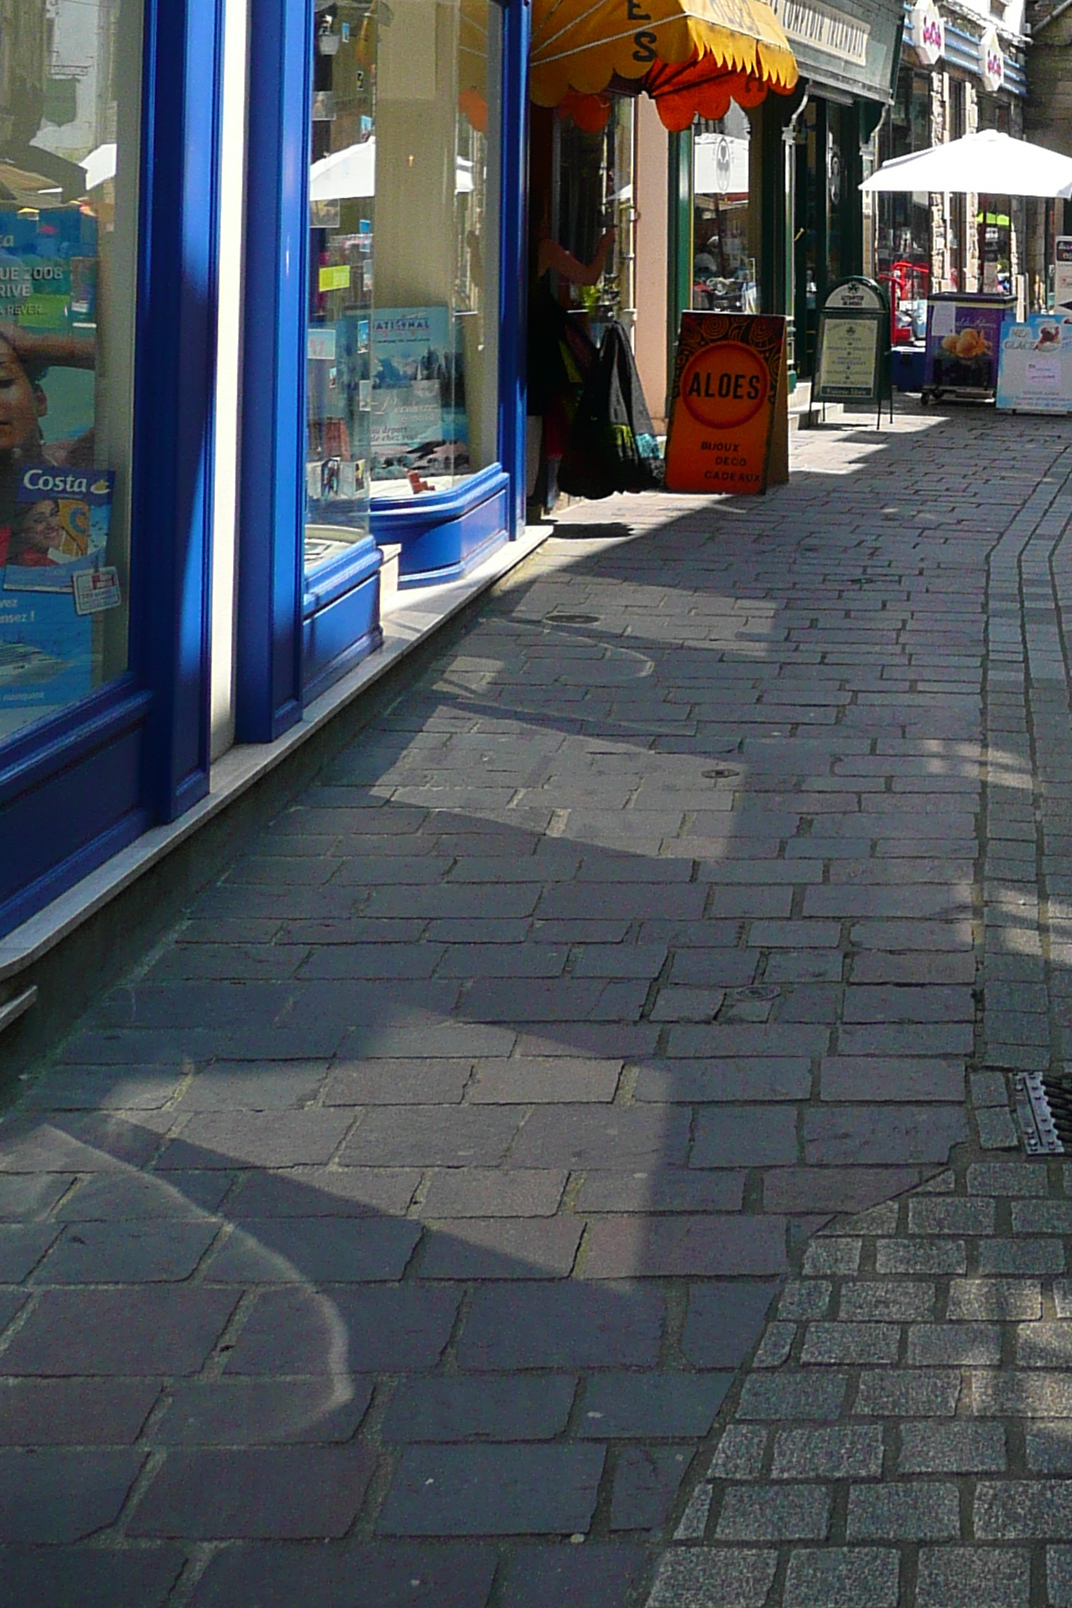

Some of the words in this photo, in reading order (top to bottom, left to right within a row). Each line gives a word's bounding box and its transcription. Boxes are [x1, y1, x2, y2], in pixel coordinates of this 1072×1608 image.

[688, 371, 760, 400] ALOES
[701, 441, 739, 452] BIJOUX
[715, 456, 747, 467] DECO
[23, 469, 88, 493] Costa
[704, 470, 760, 483] CADEAUX
